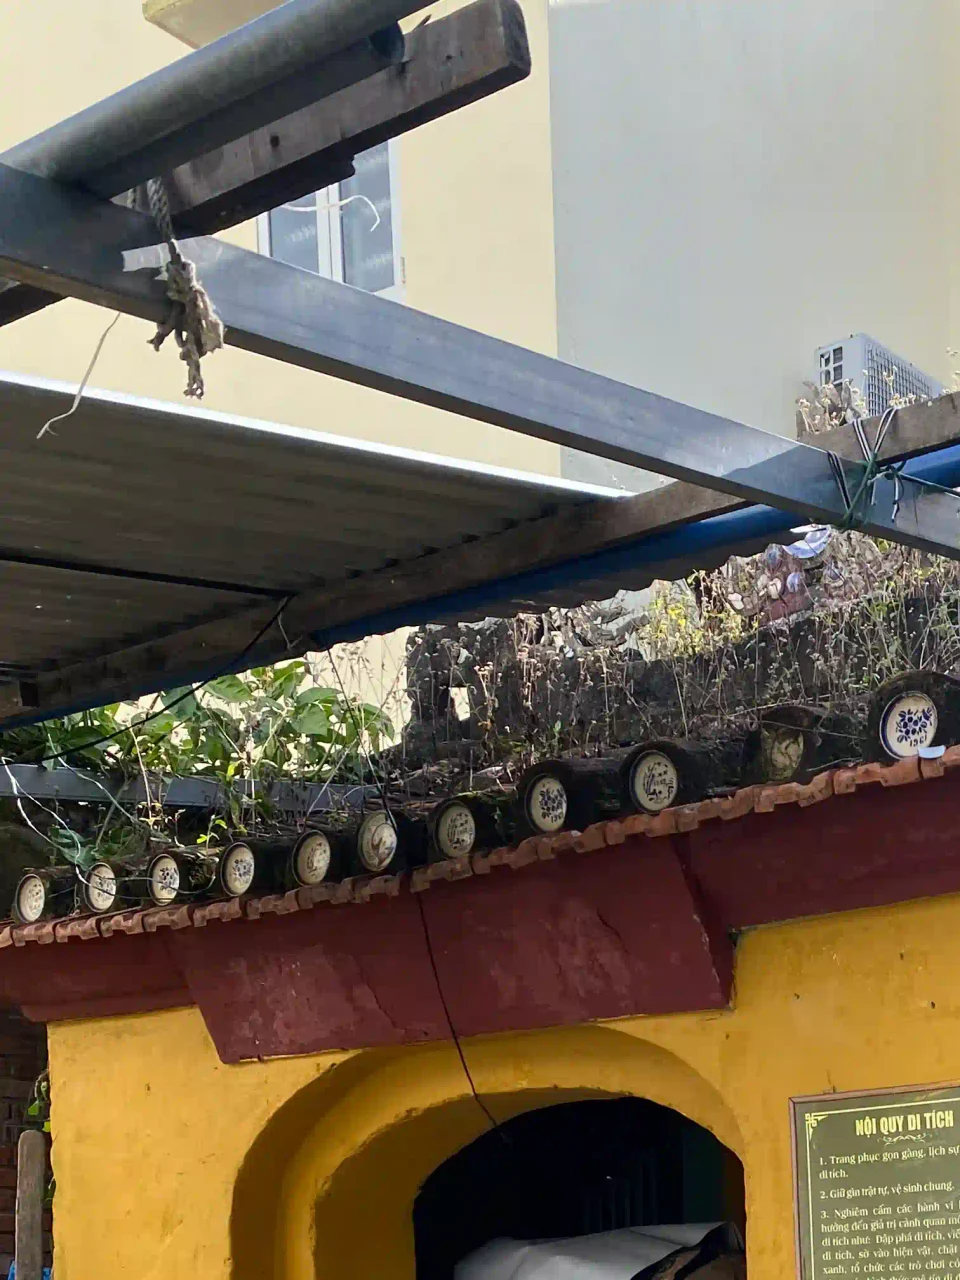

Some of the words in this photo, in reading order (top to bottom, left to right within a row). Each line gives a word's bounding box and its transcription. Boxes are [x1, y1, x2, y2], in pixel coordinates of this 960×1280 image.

[855, 1116, 876, 1138] NỘI
[880, 1117, 904, 1133] QUY
[908, 1118, 920, 1130] DI
[924, 1110, 954, 1129] TÍCH
[819, 1157, 827, 1165] 1.
[829, 1154, 855, 1165] Trang
[858, 1152, 880, 1165] phục
[882, 1150, 899, 1160] gọn
[902, 1147, 925, 1160] gàng,
[929, 1145, 945, 1158] lịch
[948, 1145, 960, 1156] sự
[819, 1170, 829, 1179] di
[829, 1169, 848, 1178] tích.
[820, 1191, 828, 1199] 2.
[830, 1188, 846, 1198] Giữ
[846, 1188, 860, 1199] gìn
[861, 1187, 876, 1197] trật
[891, 1185, 902, 1195] vệ
[903, 1183, 922, 1193] sinh
[924, 1182, 955, 1192] chung.
[821, 1210, 829, 1219] 3.
[834, 1208, 868, 1219] Nghiêm
[873, 1204, 892, 1215] cấm
[897, 1205, 912, 1213] các
[917, 1202, 939, 1212] hành
[821, 1220, 849, 1233] hưởng
[851, 1219, 868, 1231] đến
[886, 1218, 897, 1229] trị
[899, 1215, 920, 1228] cảnh
[923, 1216, 946, 1227] quan
[822, 1236, 831, 1246] di
[832, 1235, 849, 1245] tích
[851, 1234, 871, 1244] như:
[896, 1231, 912, 1244] phá
[914, 1231, 924, 1241] di
[823, 1251, 831, 1260] di
[859, 1249, 870, 1258] sờ
[873, 1248, 889, 1257] vào
[893, 1247, 913, 1258] hiện
[823, 1265, 847, 1274] xanh,
[851, 1262, 860, 1273] tổ
[864, 1262, 885, 1272] chức
[889, 1261, 904, 1271] các
[909, 1261, 921, 1270] trò
[925, 1259, 945, 1270] chơi
[949, 1259, 960, 1269] có
